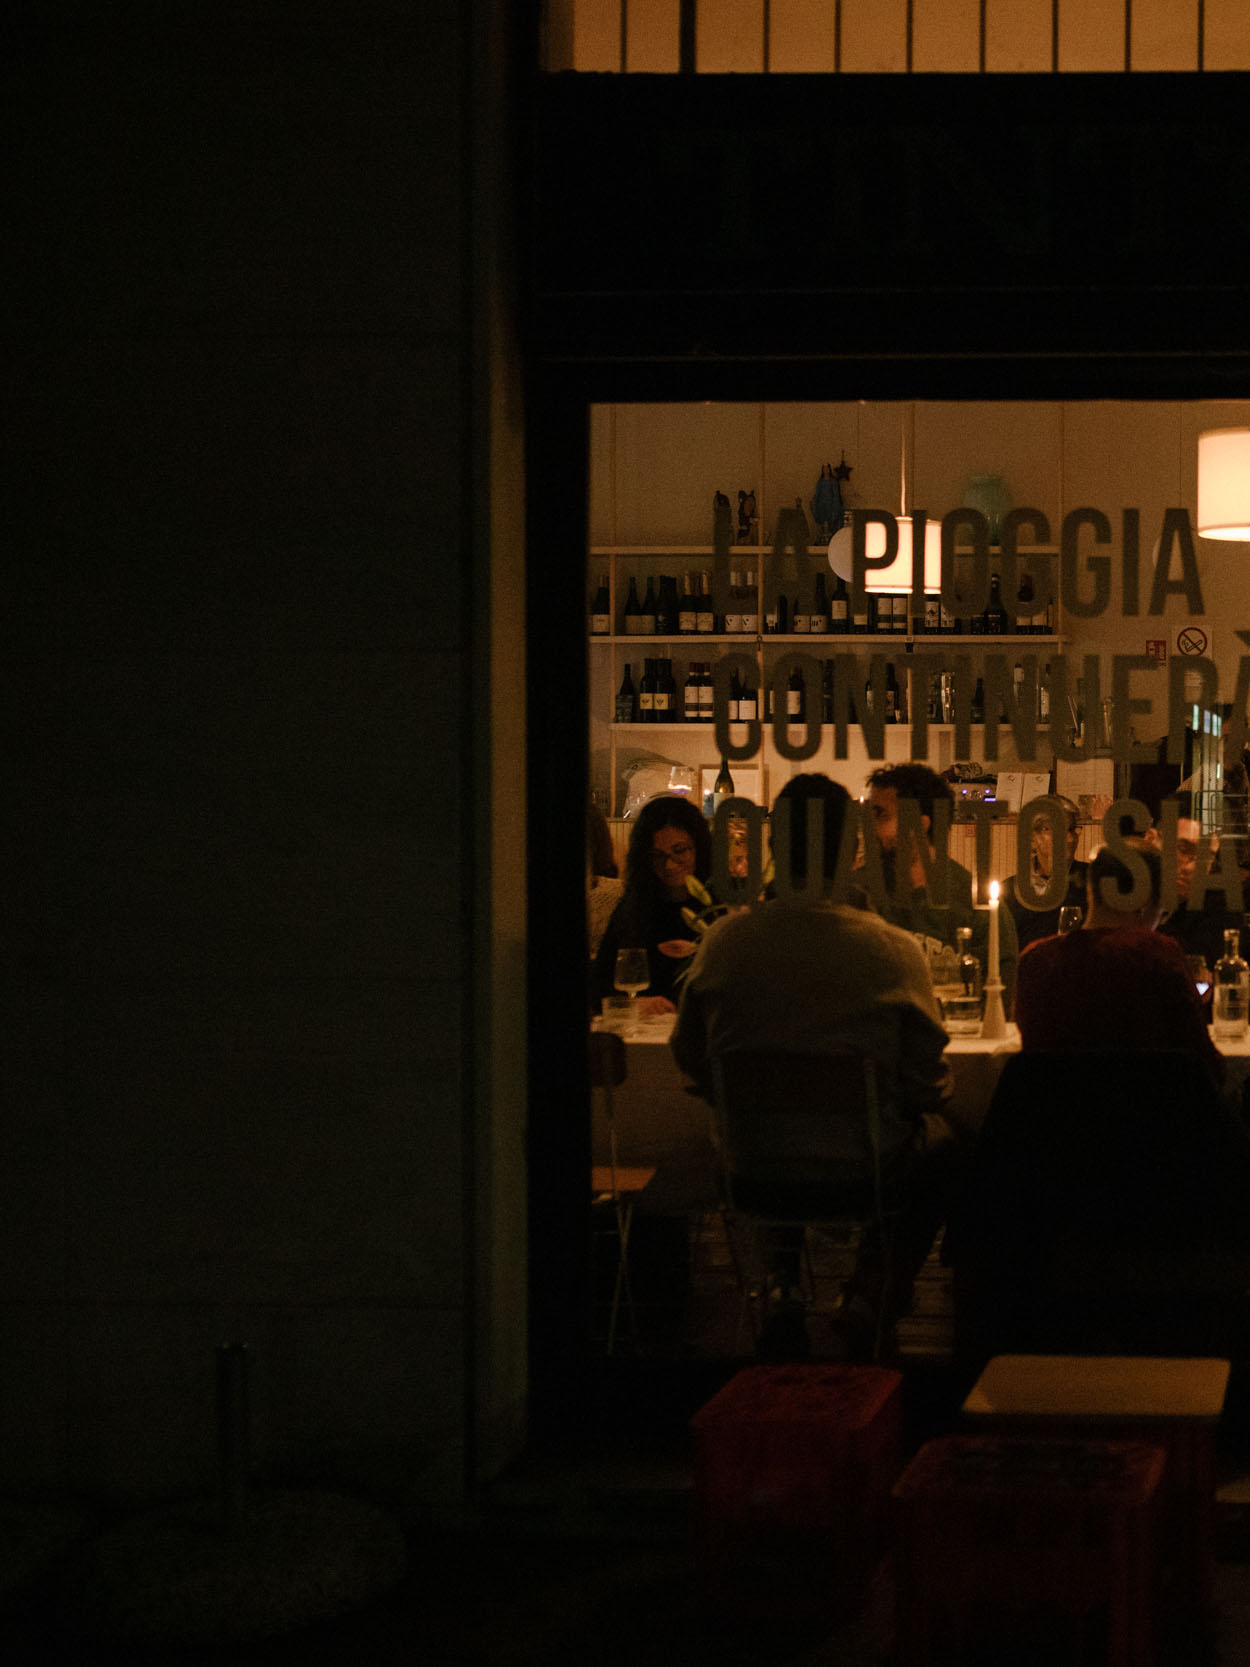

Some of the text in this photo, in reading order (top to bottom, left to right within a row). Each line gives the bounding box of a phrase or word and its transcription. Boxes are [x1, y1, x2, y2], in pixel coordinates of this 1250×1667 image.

[713, 508, 1205, 616] LA PIOGGIA
[712, 796, 1072, 913] QUANTO
